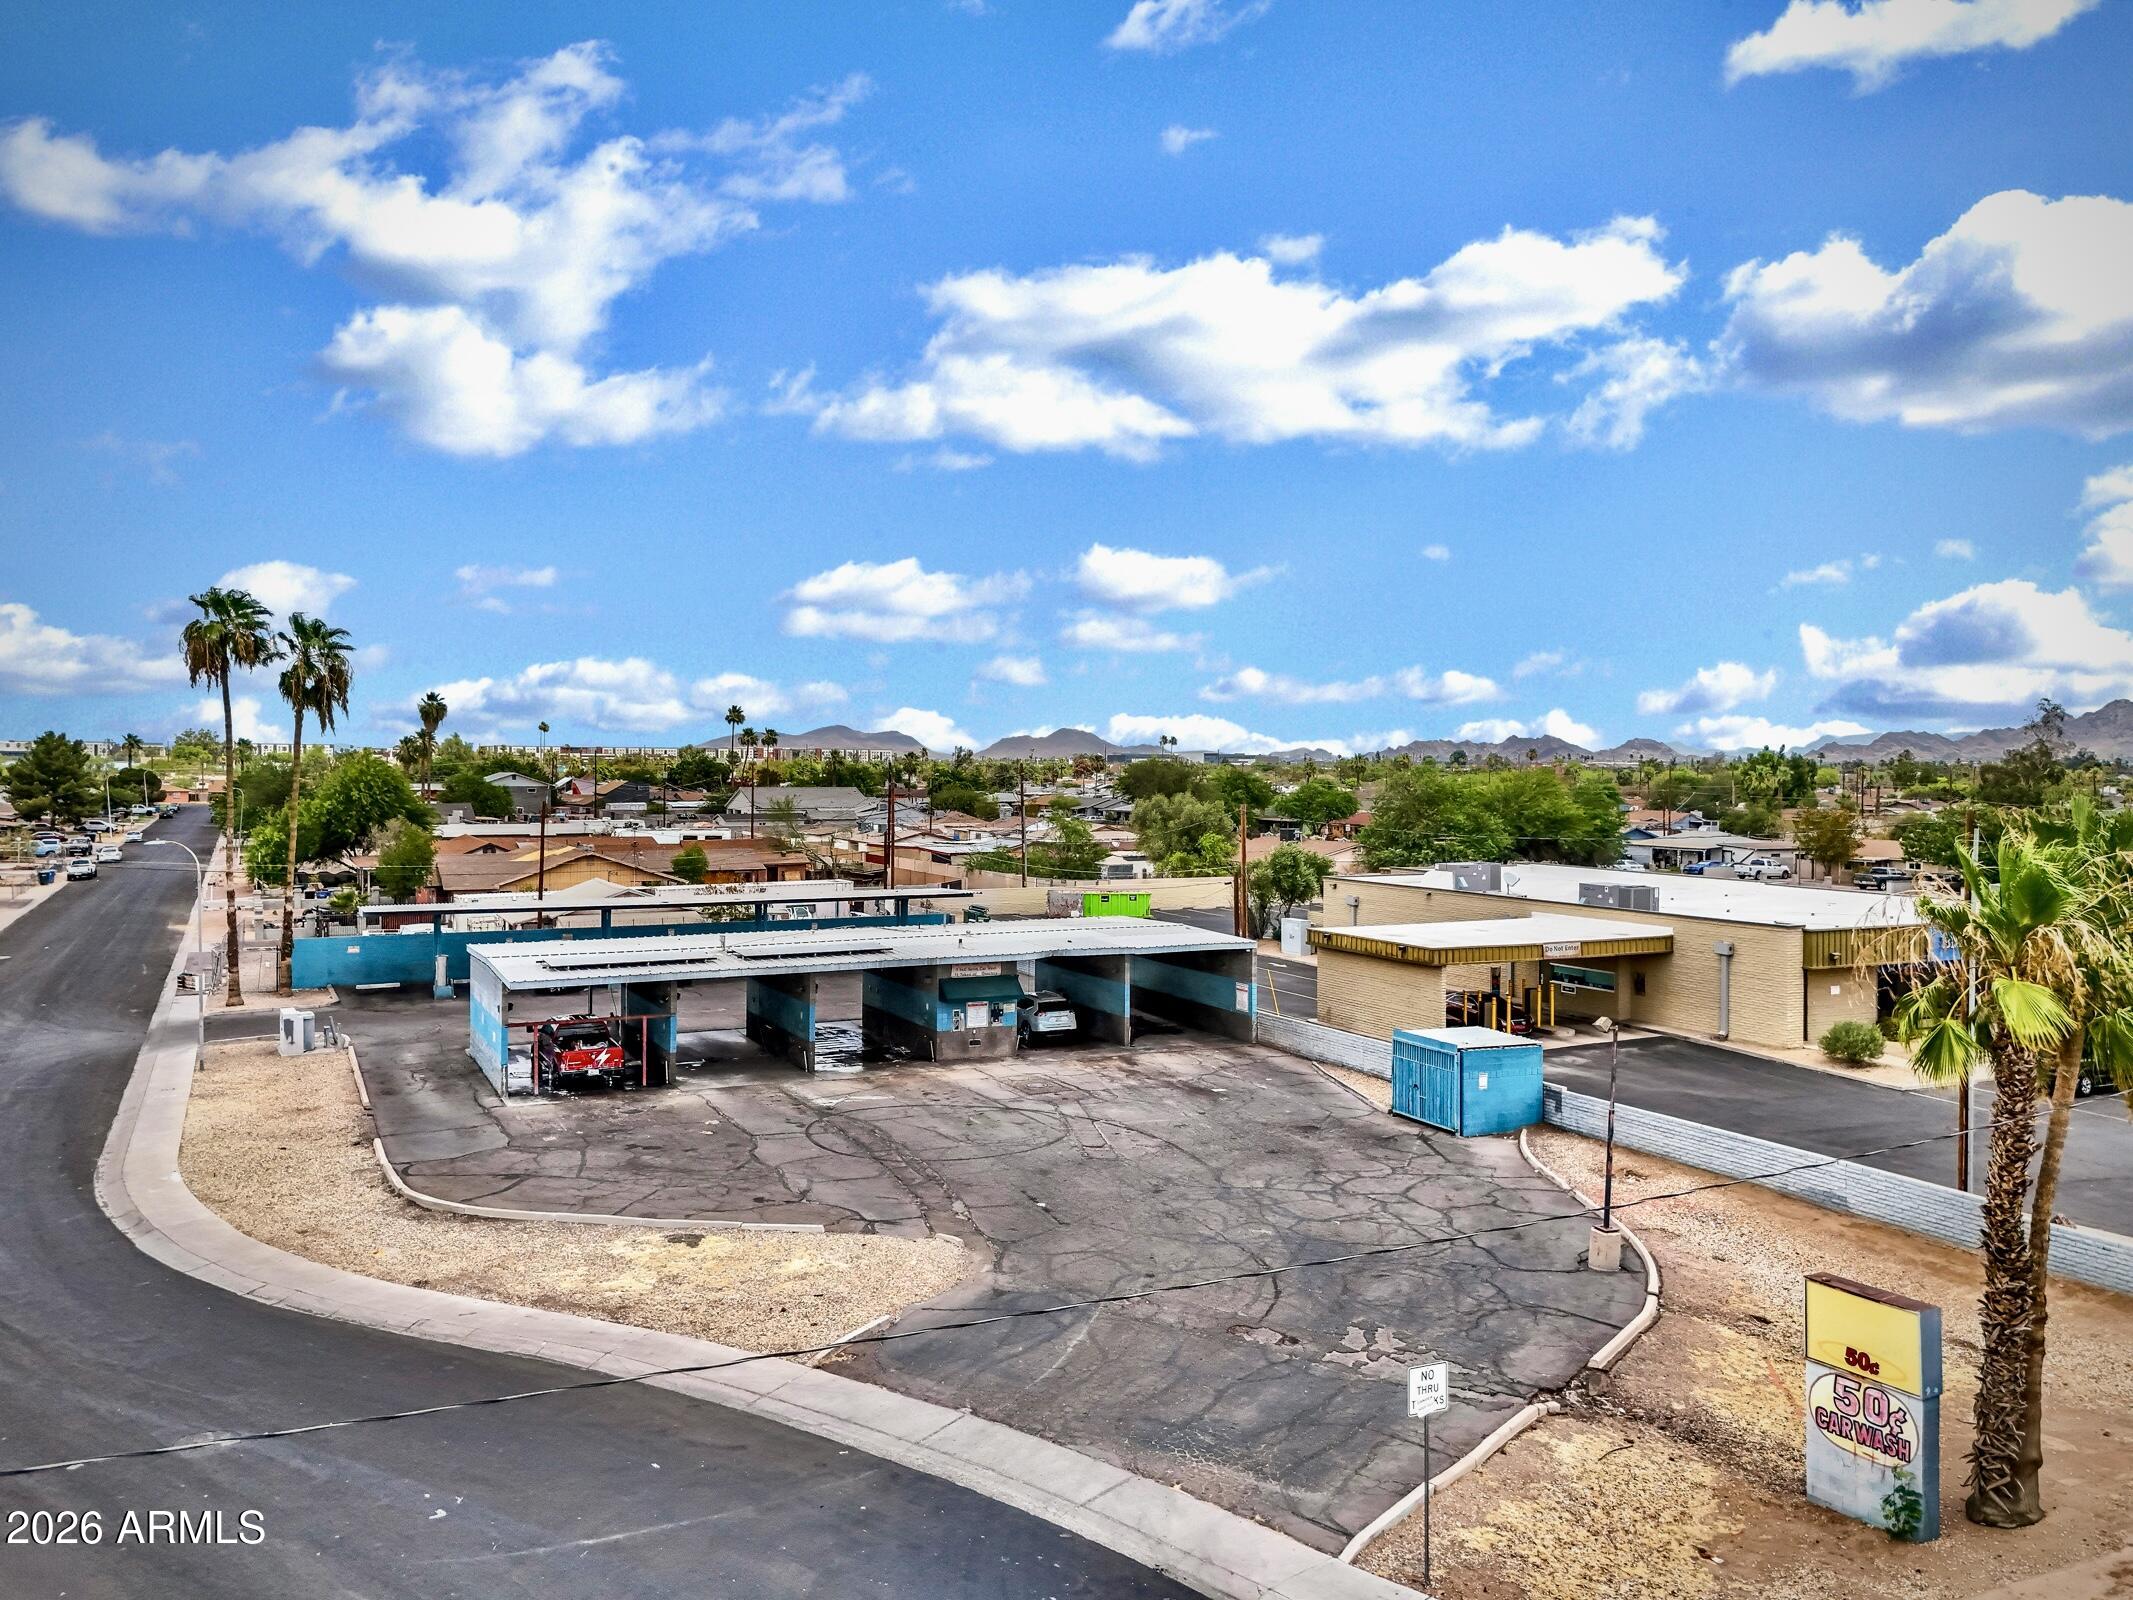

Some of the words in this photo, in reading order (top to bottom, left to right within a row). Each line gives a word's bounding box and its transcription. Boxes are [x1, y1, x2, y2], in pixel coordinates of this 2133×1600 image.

[1844, 1346, 1880, 1376] 50¢
[1421, 1369, 1434, 1381] NO
[1417, 1383, 1439, 1395] THRU
[1412, 1395, 1444, 1409] TKS
[1833, 1374, 1907, 1437] 50¢
[1815, 1406, 1853, 1442] CAR
[1853, 1420, 1912, 1464] WASH
